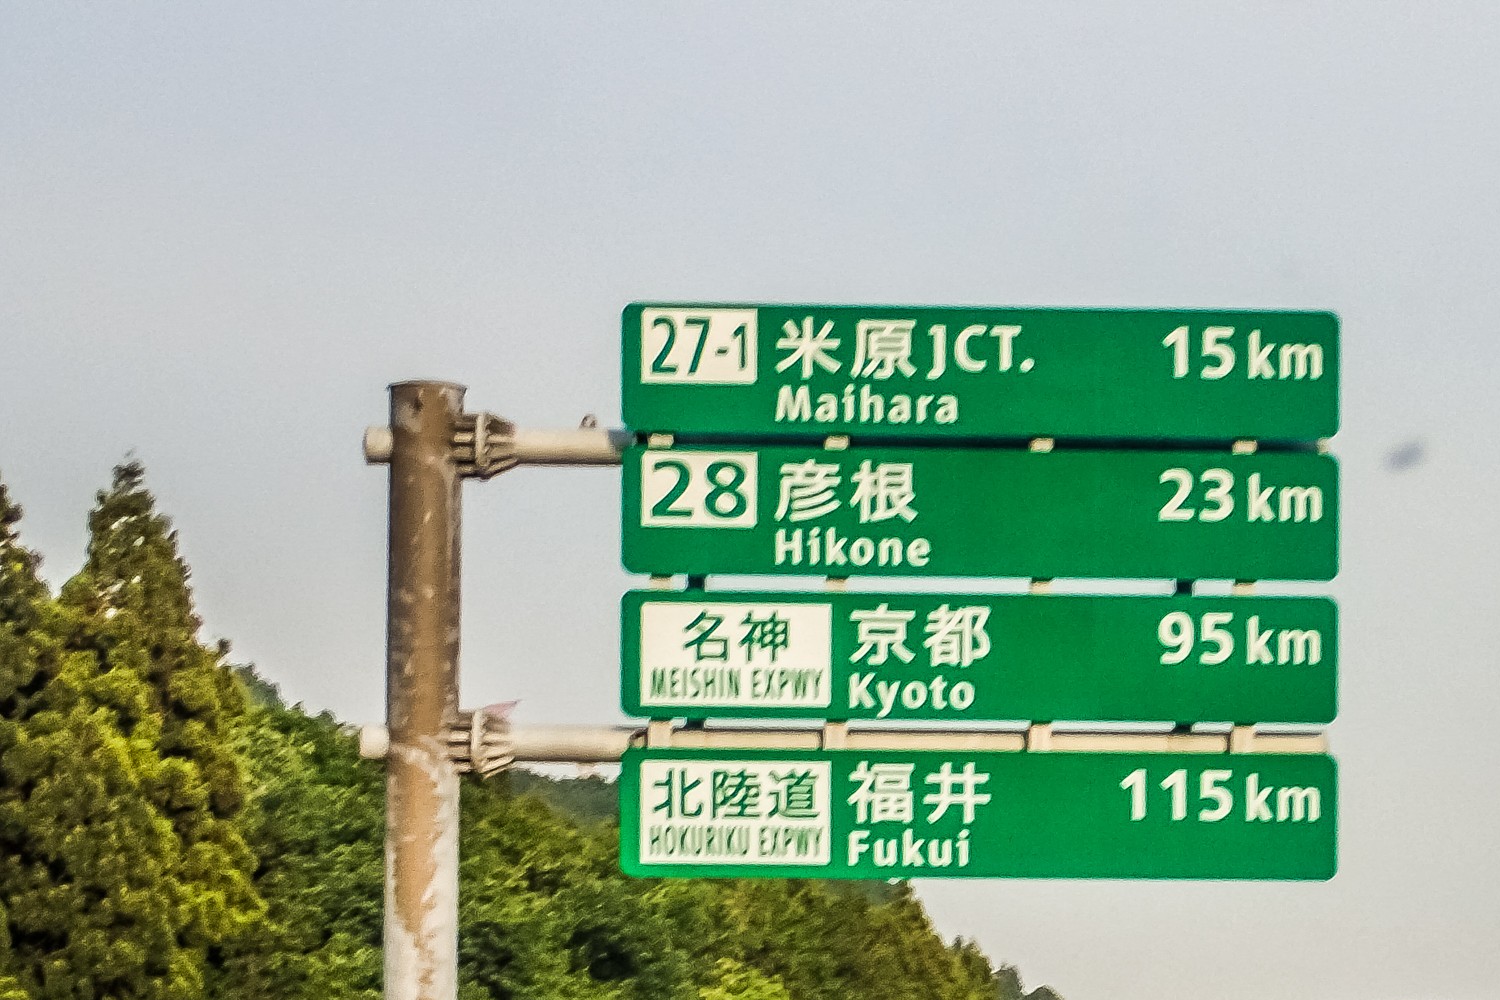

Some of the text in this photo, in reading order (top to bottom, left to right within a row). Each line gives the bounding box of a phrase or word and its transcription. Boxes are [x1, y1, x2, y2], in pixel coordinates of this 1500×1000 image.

[649, 314, 750, 377] 27-1
[775, 385, 960, 425] Maihara
[649, 459, 750, 518] 28
[774, 528, 931, 567] Hikone
[682, 610, 790, 664] 名神
[849, 604, 992, 667] 京都
[650, 667, 823, 699] MEISHIN EXPWY
[848, 673, 976, 718] Kyoto
[650, 767, 823, 820] 北陸道
[848, 761, 992, 825] 福井
[649, 825, 823, 857] HOKURIKU EXPWY
[847, 829, 971, 867] Fukui
